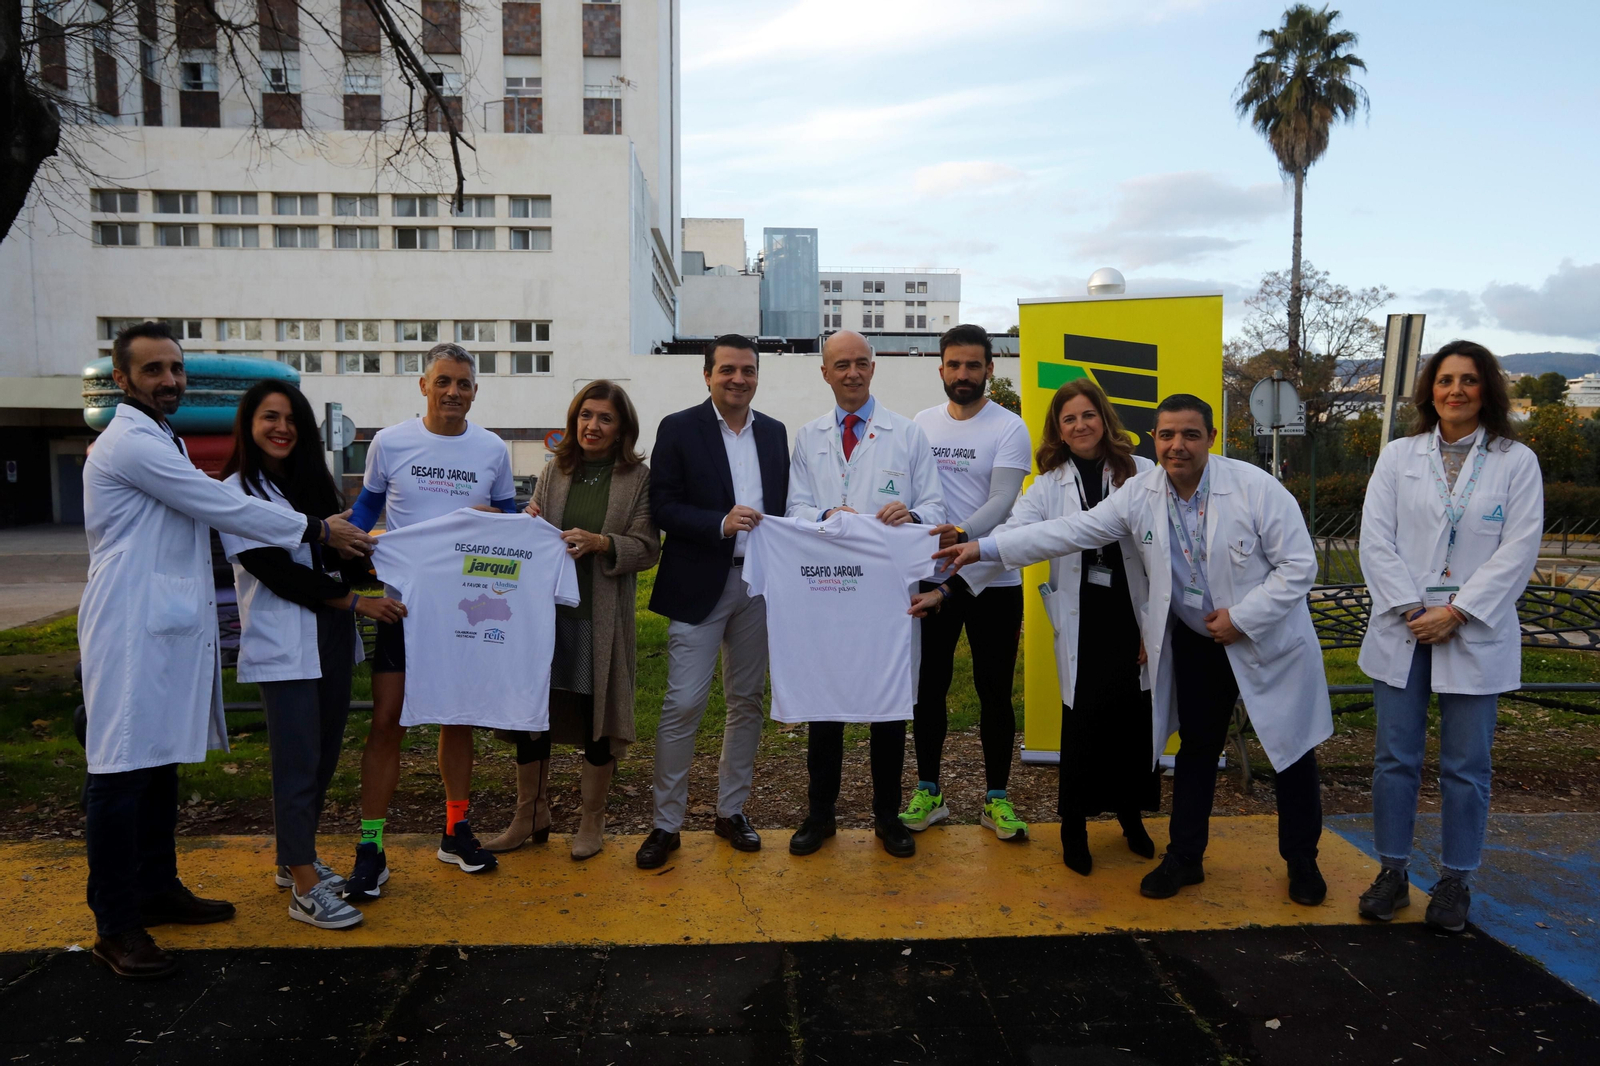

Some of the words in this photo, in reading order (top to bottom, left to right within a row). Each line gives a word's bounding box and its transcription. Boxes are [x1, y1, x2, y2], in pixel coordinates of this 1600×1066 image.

[951, 448, 976, 460] JARQUIL
[411, 465, 445, 479] DESAFIO
[446, 469, 478, 483] JARQUIL
[428, 479, 454, 488] sonrisa
[418, 486, 449, 494] nuestros
[450, 489, 470, 497] pasos
[454, 543, 490, 555] DESAFIO
[491, 546, 533, 560] SOLIDARIO
[467, 558, 518, 576] jarquil
[800, 565, 831, 577] DESAFIO
[832, 565, 864, 577] JARQUIL
[838, 585, 857, 593] pasos
